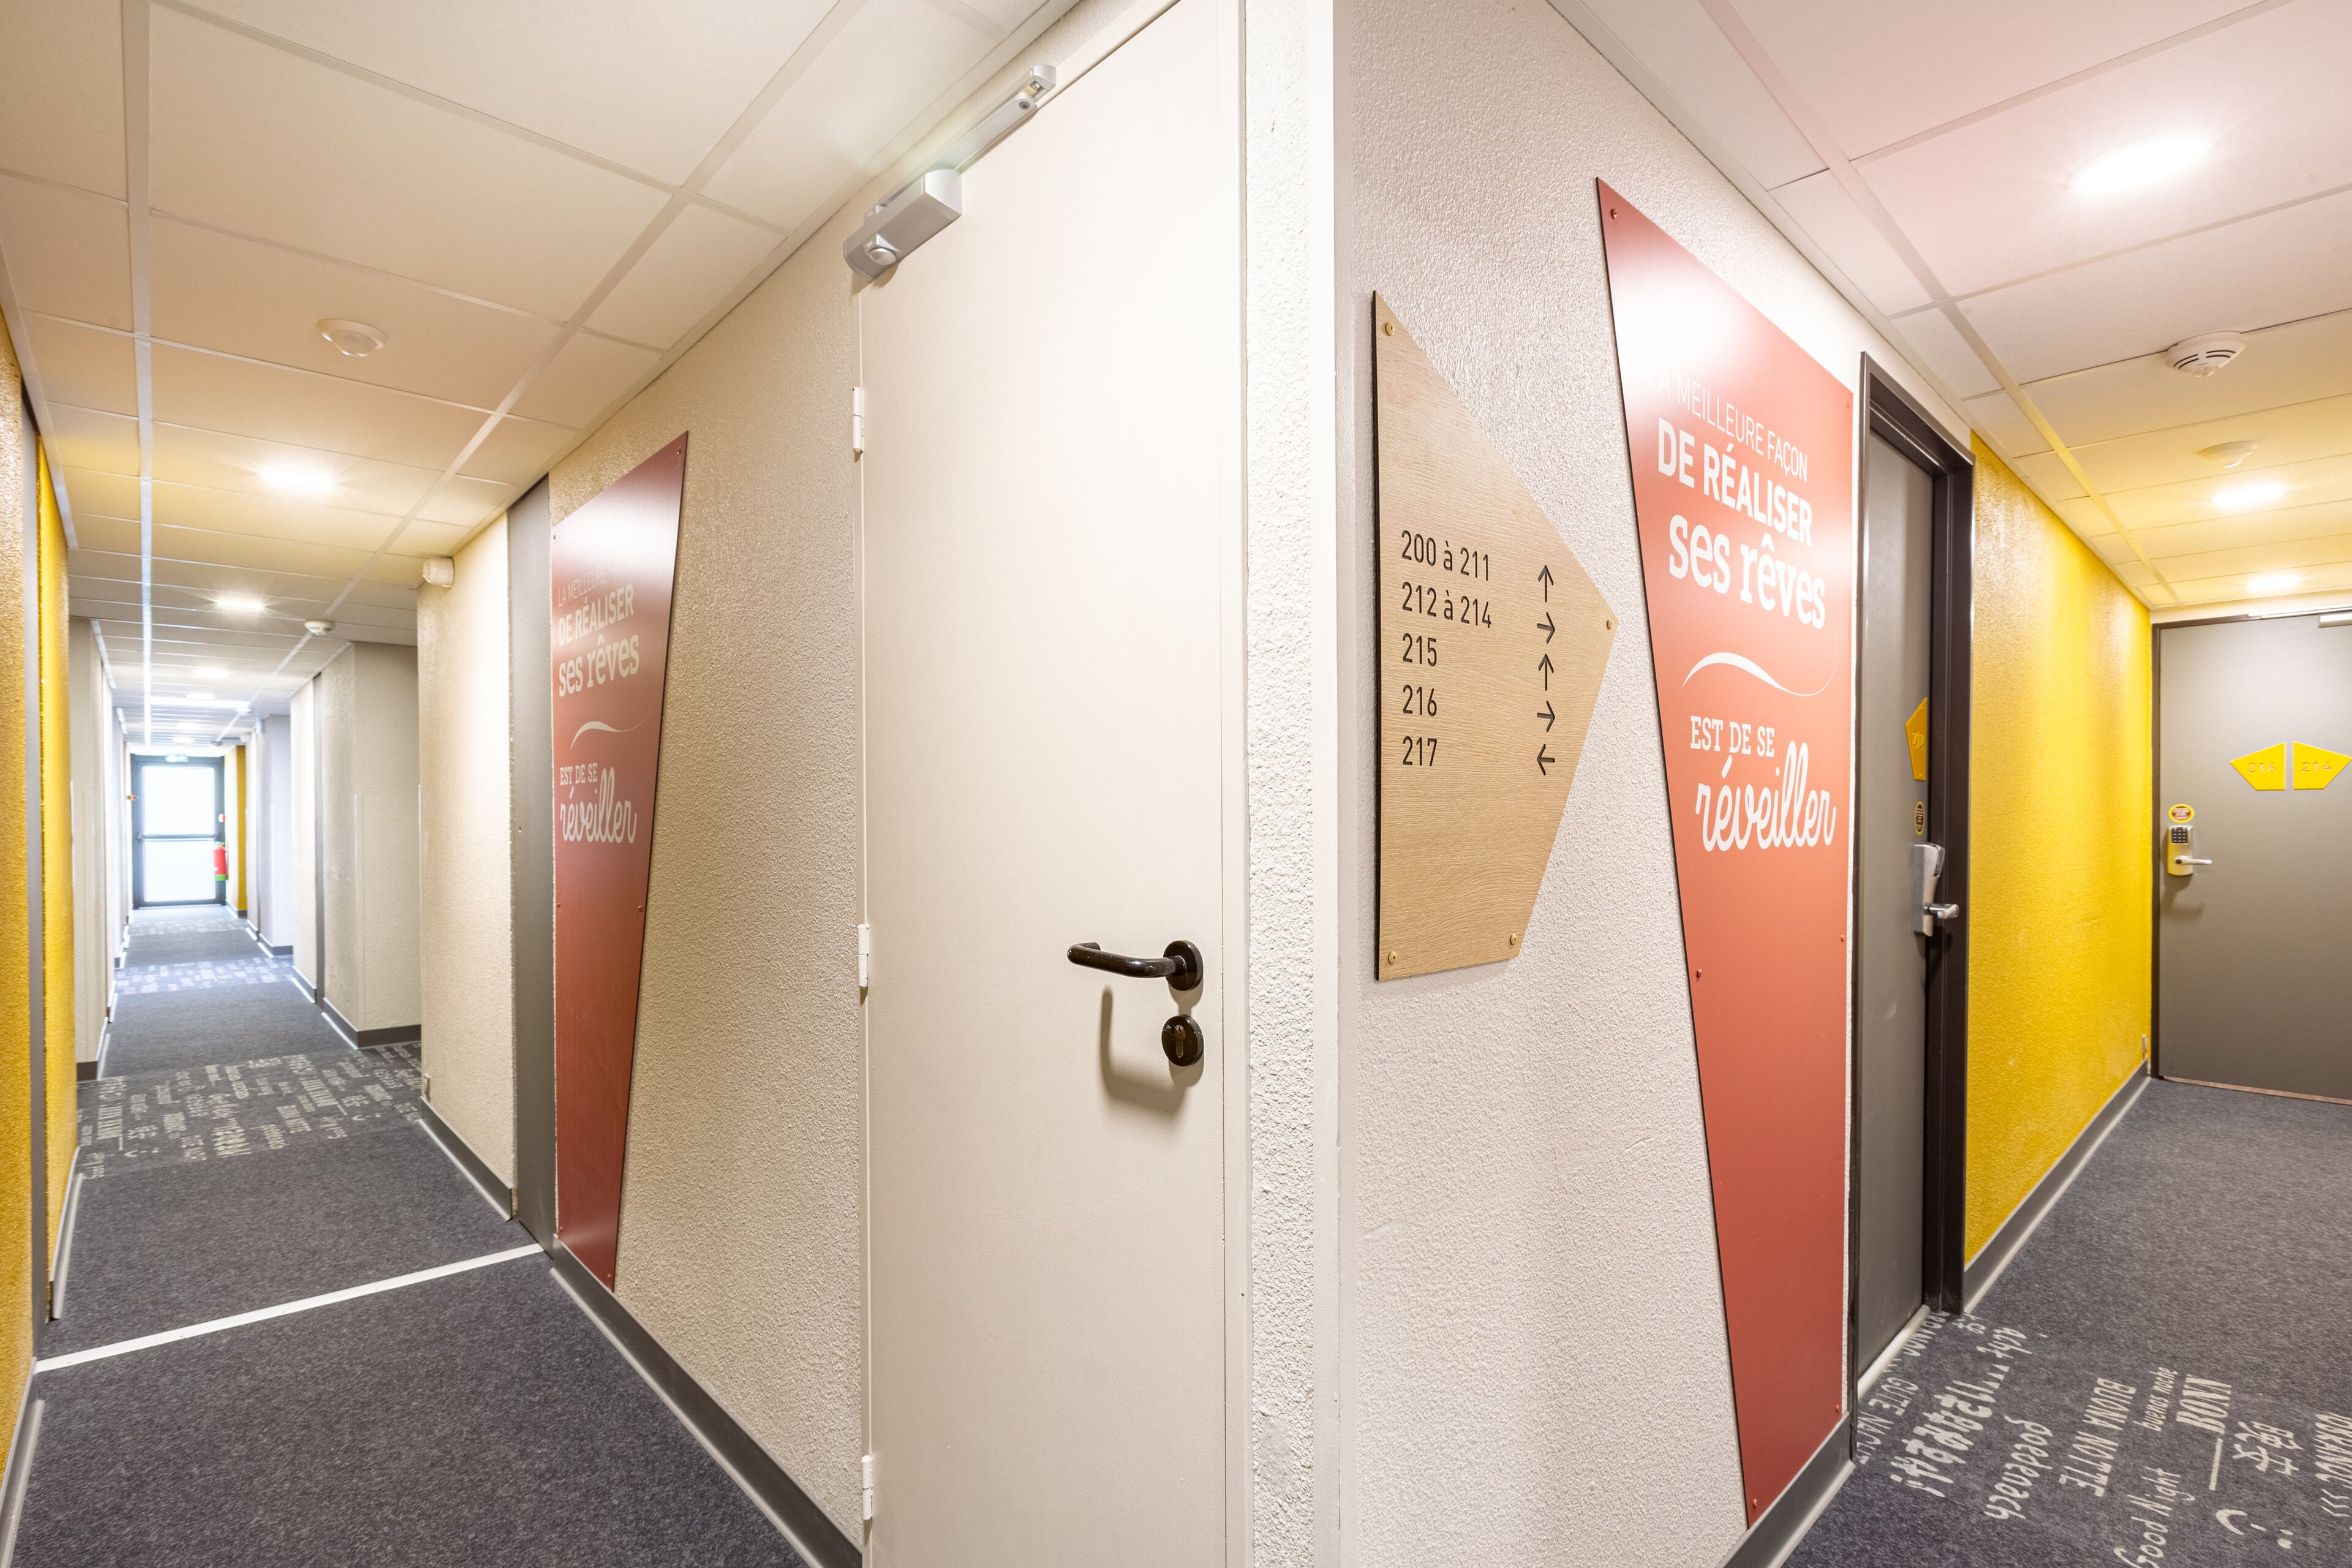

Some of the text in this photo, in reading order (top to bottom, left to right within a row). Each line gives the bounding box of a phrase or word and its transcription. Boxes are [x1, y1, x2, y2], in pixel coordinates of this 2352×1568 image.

[1677, 369, 1764, 456] MEILLEURE
[1768, 431, 1807, 483] FAÇON
[1658, 417, 1812, 547] DE RÉALISER
[1401, 530, 1489, 581] 200 à 211
[1669, 514, 1826, 630] ses rêves
[559, 583, 634, 647] DE RÉALISER
[1402, 581, 1491, 628] 212 à 214
[559, 634, 640, 696] ses rêves
[1402, 633, 1438, 666] 215
[1403, 684, 1438, 717] 216
[1403, 736, 1438, 767] 217
[1690, 715, 1775, 758] EST DE SE
[560, 763, 598, 786] EST DE SE
[2248, 763, 2276, 772] 216
[2301, 761, 2332, 772] 214
[560, 767, 638, 844] réveiller
[1695, 739, 1837, 853] réveiller
[1868, 1378, 1919, 1415] GUTE
[2133, 1367, 2177, 1431] buenas noche
[2059, 1378, 2136, 1496] BUONA NOTTE
[2127, 1467, 2196, 1516] Night
